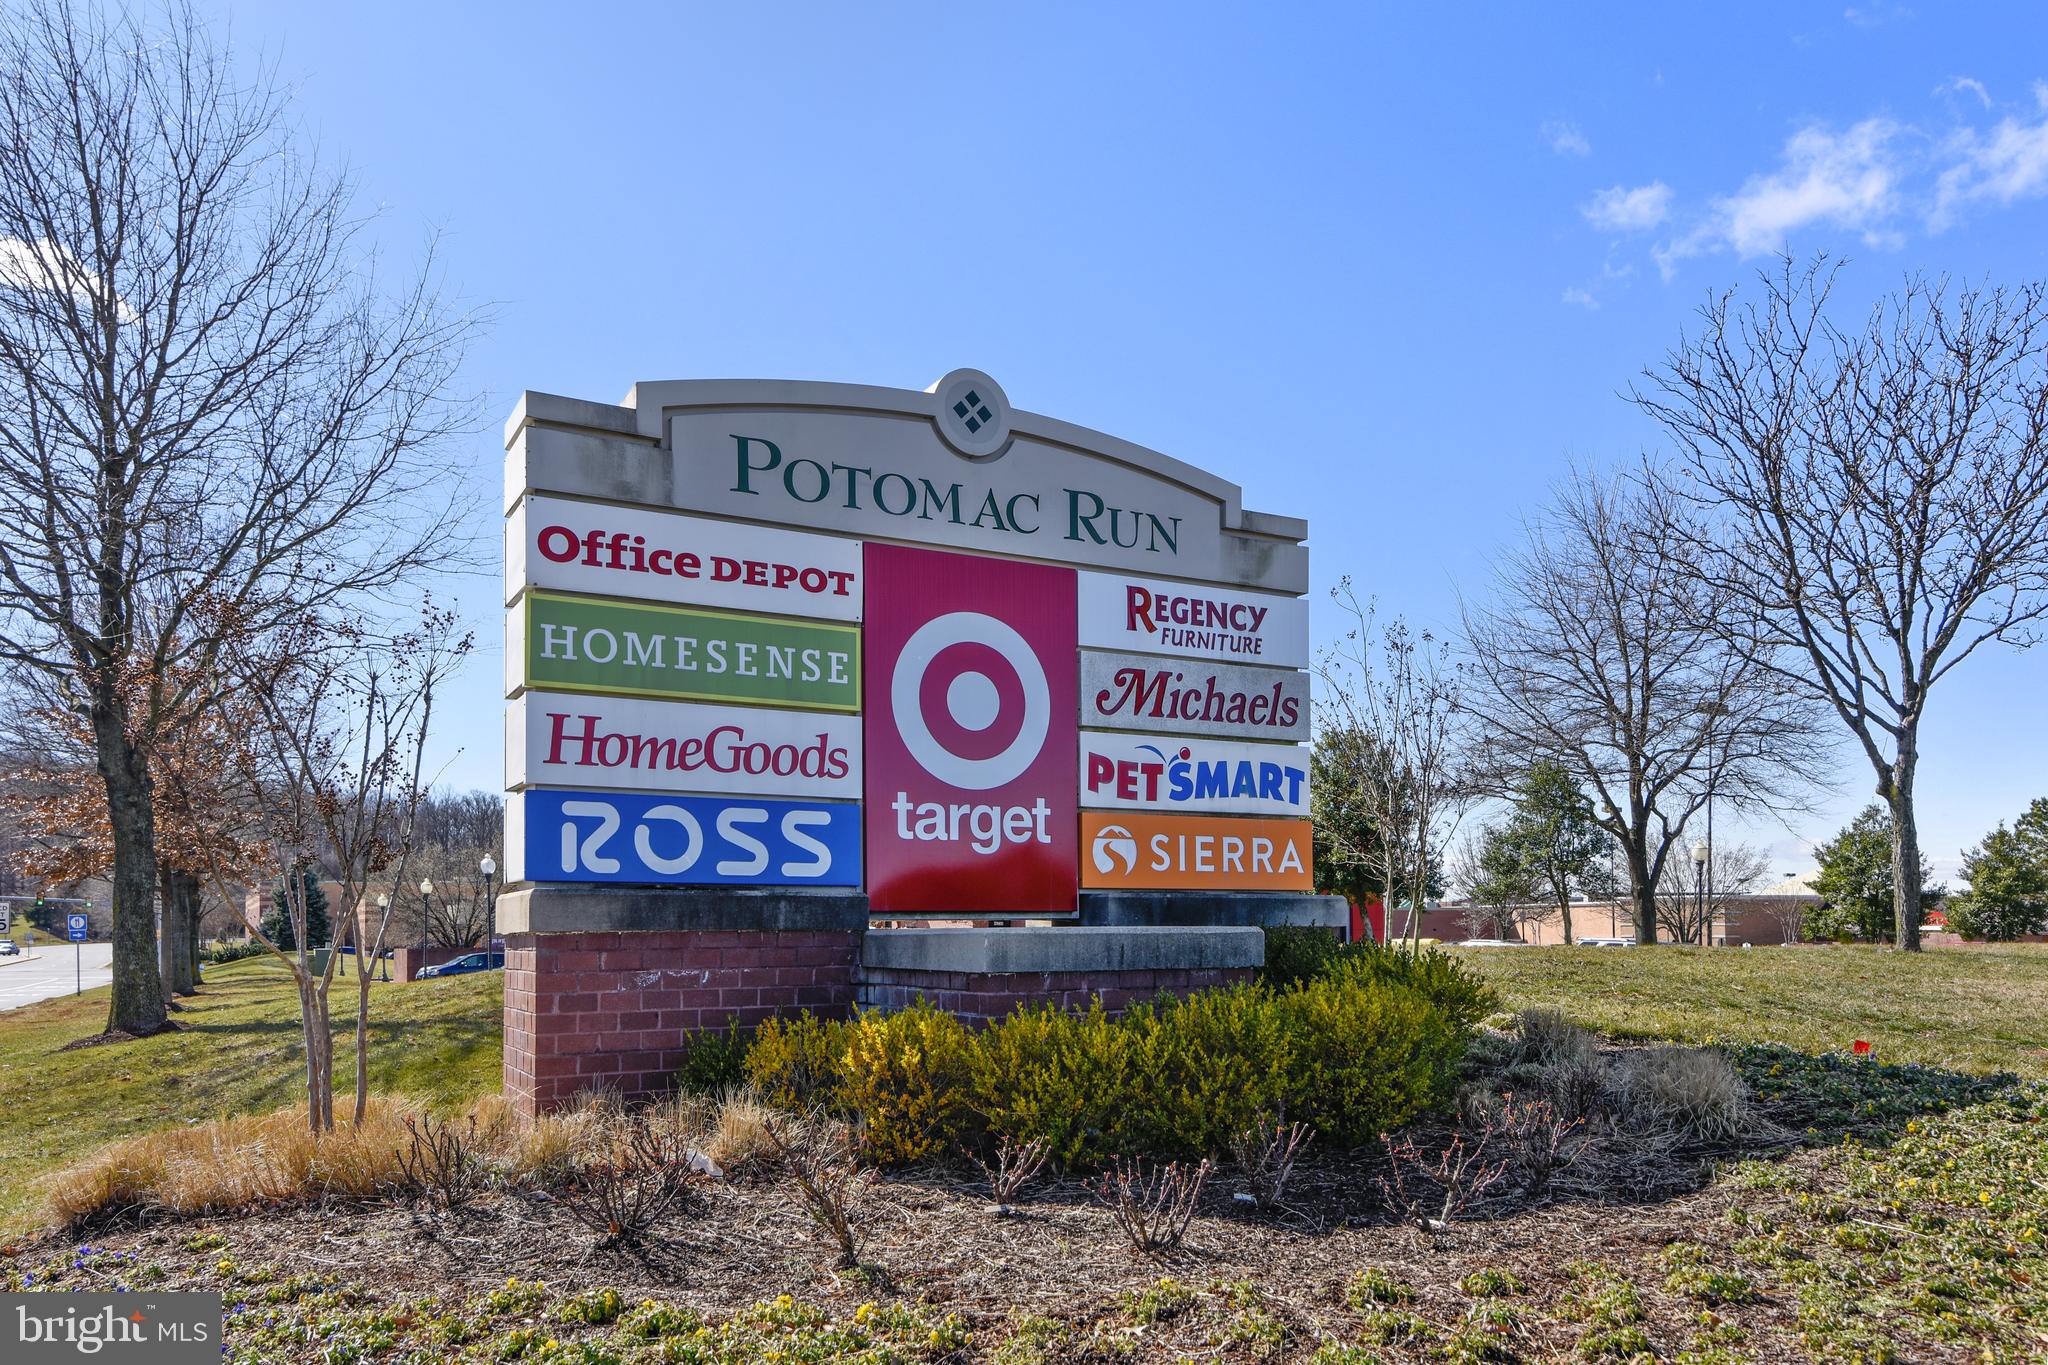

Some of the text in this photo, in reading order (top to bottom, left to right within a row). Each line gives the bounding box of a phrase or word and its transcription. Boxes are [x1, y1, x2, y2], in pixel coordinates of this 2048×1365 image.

[729, 434, 1183, 556] POTOMAC RUN
[537, 525, 855, 597] Office DEPOT
[1126, 584, 1268, 634] REGENCY
[540, 623, 849, 684] HOMESENSE
[1161, 627, 1263, 655] FURNITURE
[1095, 667, 1299, 727] Michaels
[542, 713, 849, 780] HomeGoods
[1087, 749, 1306, 806] PETSMART
[561, 800, 832, 878] ROSS
[891, 791, 1051, 855] target
[1150, 833, 1305, 874] SIERRA
